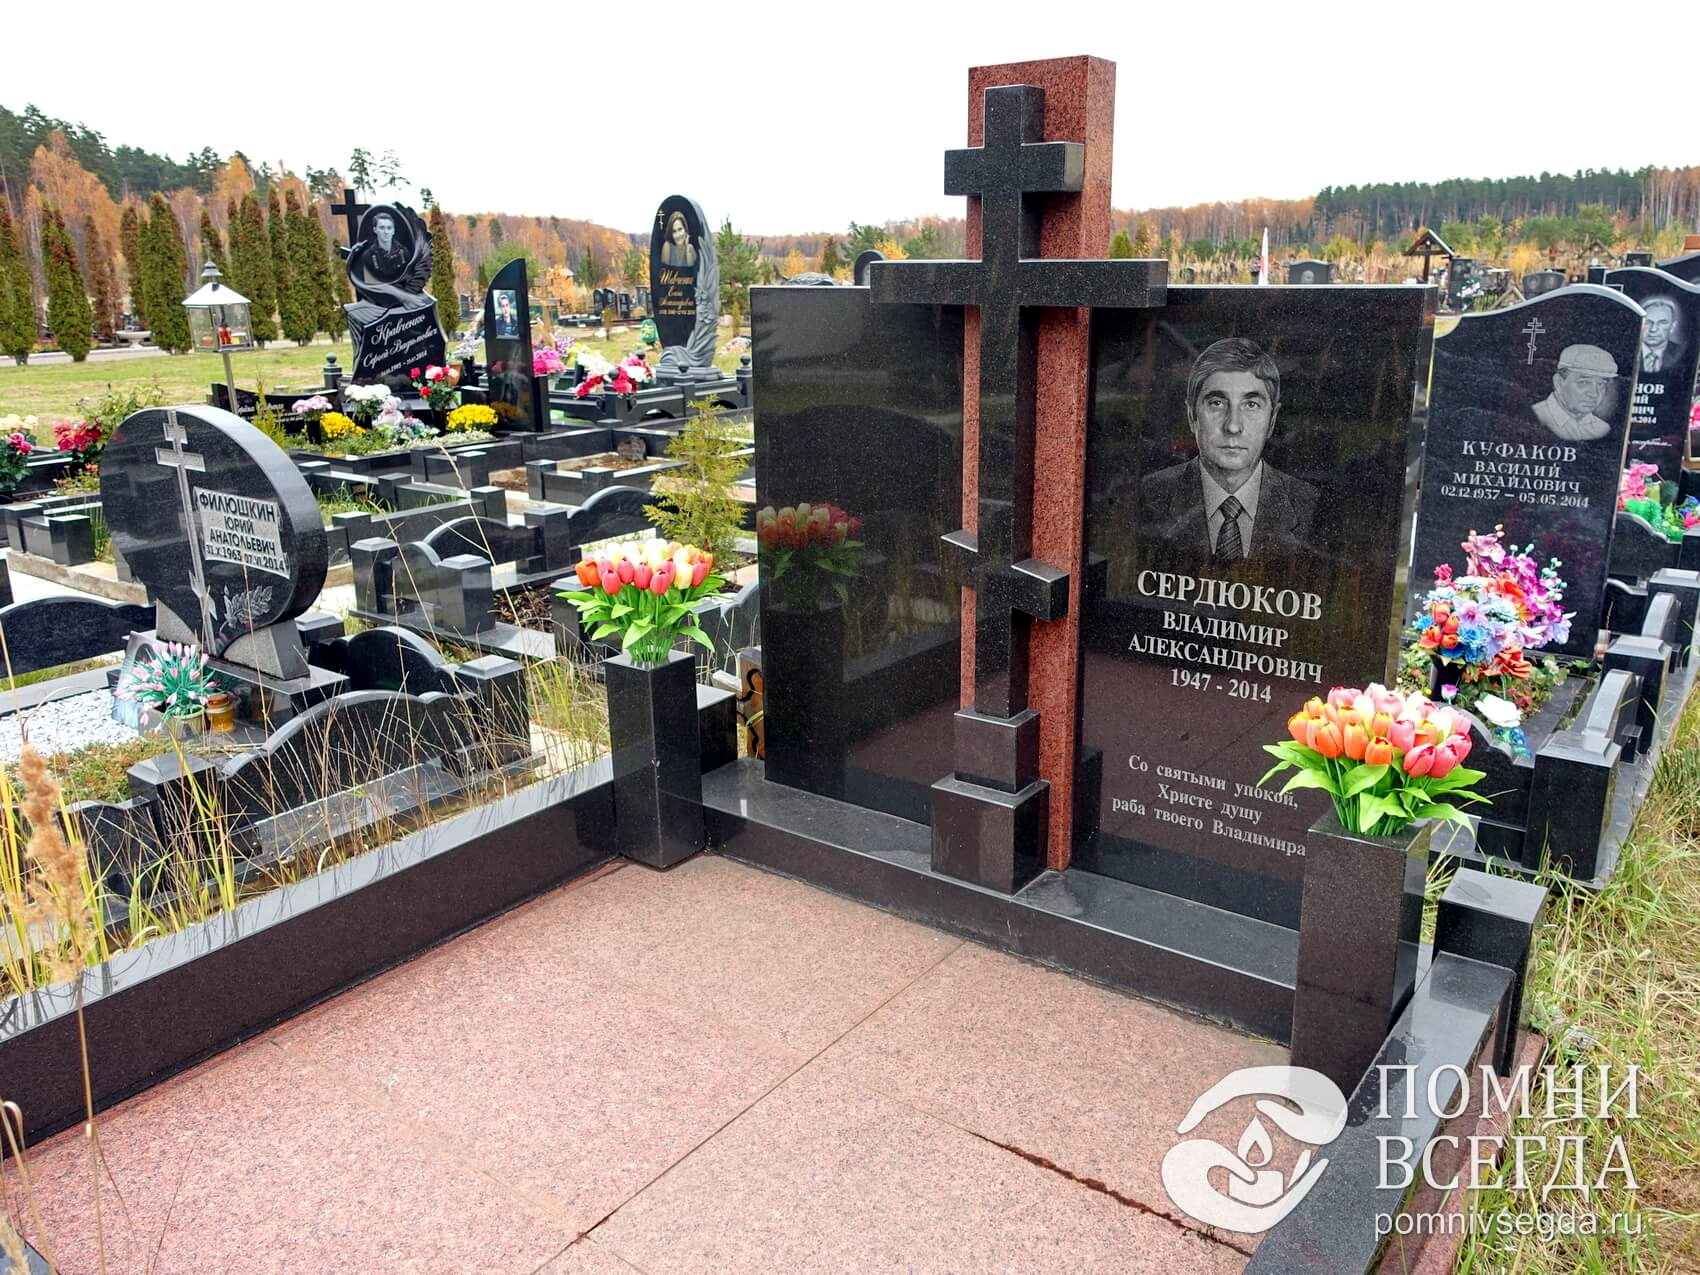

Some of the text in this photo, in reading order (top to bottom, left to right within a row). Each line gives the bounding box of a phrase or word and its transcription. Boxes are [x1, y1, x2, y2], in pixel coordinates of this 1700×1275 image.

[1461, 440, 1577, 462] КУФАКОВ
[1453, 472, 1580, 493] МИХАЙЛОВИЧ
[1474, 460, 1561, 478] ВАСИЛИЙ
[199, 493, 276, 522] ФИЛЮШКИН
[1440, 485, 1501, 500] 02.12.1937
[1518, 492, 1590, 508] 05.05.2014
[223, 515, 254, 535] ЮРИЙ
[209, 528, 277, 556] АНАТОЛЬЕВИЧ
[1137, 569, 1323, 621] СЕРДЮКОВ
[1162, 610, 1289, 648] ВЛАДИМИР
[1128, 633, 1324, 684] АЛЕКСАНДРОВИЧ
[1170, 668, 1212, 692] 1947
[1228, 679, 1272, 704] 2014
[1128, 754, 1299, 810] Со святыми упокой,
[1157, 783, 1263, 825] Христе душу
[1112, 797, 1307, 857] раба твоего Владимира
